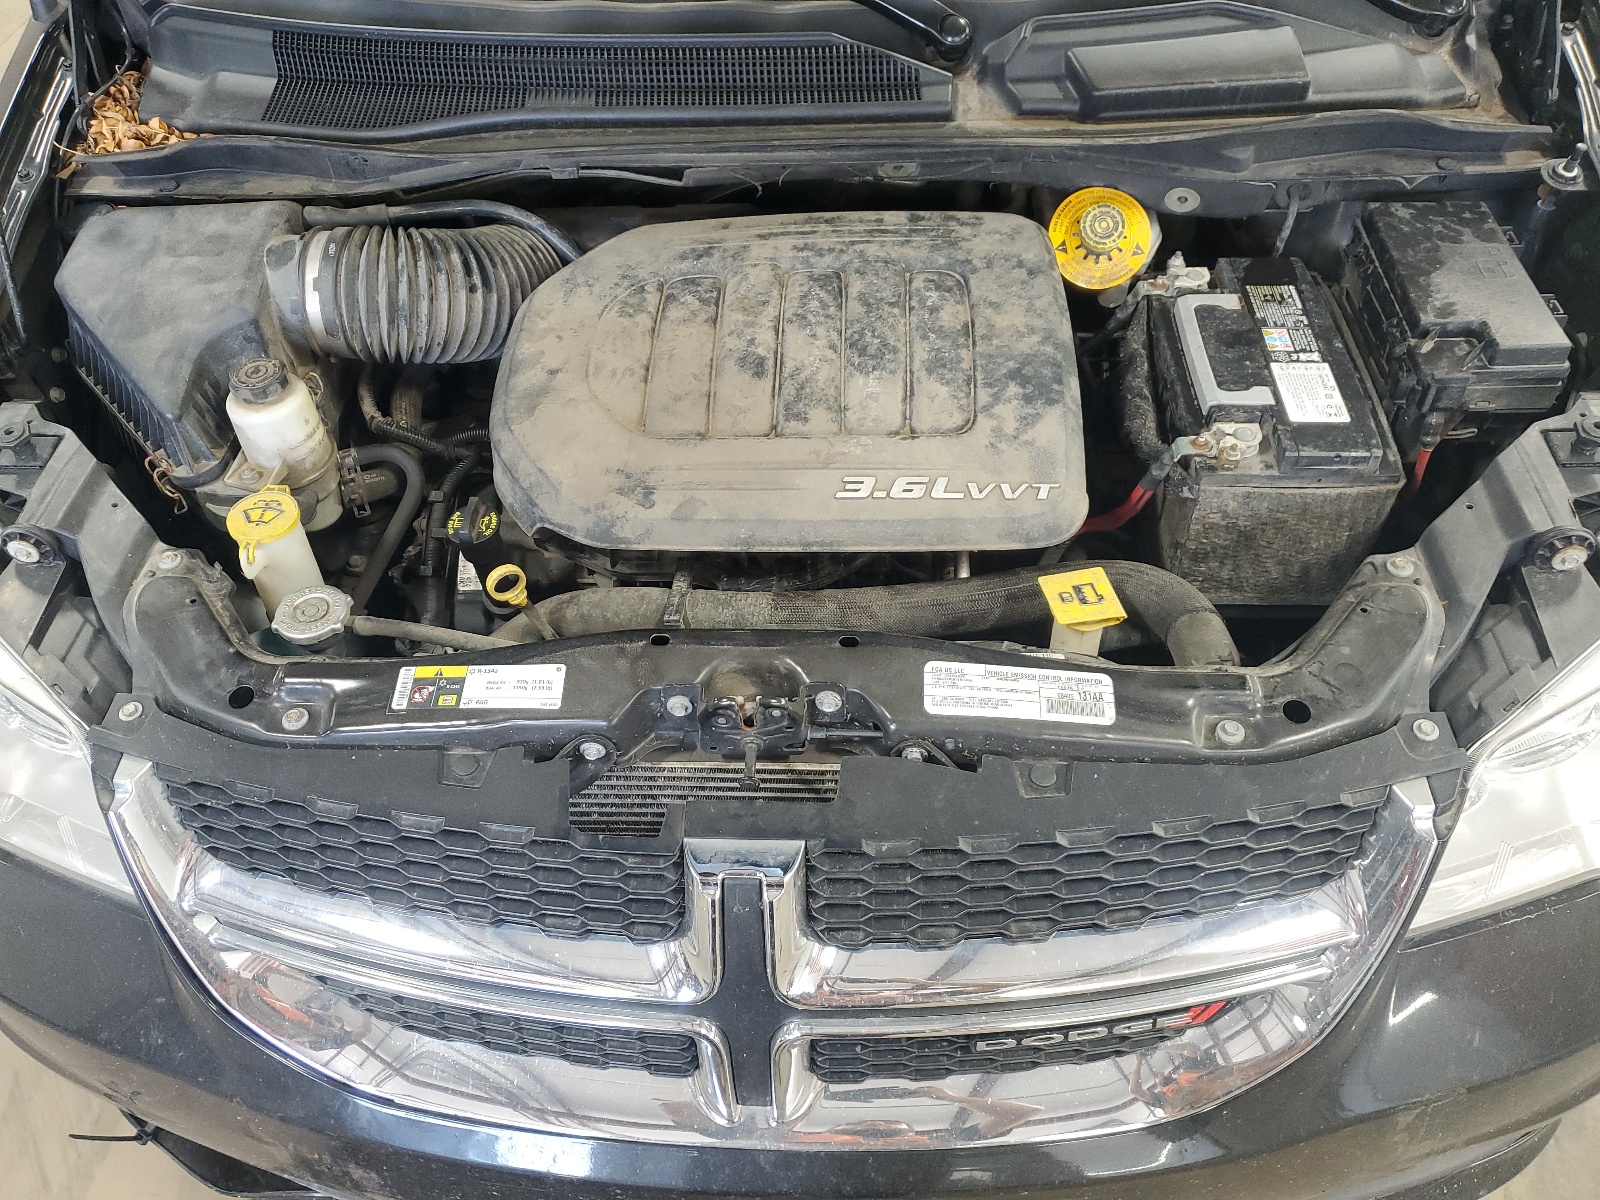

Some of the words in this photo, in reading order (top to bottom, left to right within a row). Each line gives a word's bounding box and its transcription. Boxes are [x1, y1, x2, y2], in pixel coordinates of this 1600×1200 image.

[965, 481, 1061, 500] VVT
[986, 670, 1009, 678] VEHICLE
[1010, 672, 1037, 680] EMISSION
[1038, 674, 1063, 682] CONTROL
[1064, 676, 1104, 685] INFORMATION
[1077, 691, 1104, 702] 131AA
[975, 1012, 1193, 1052] DODGE
